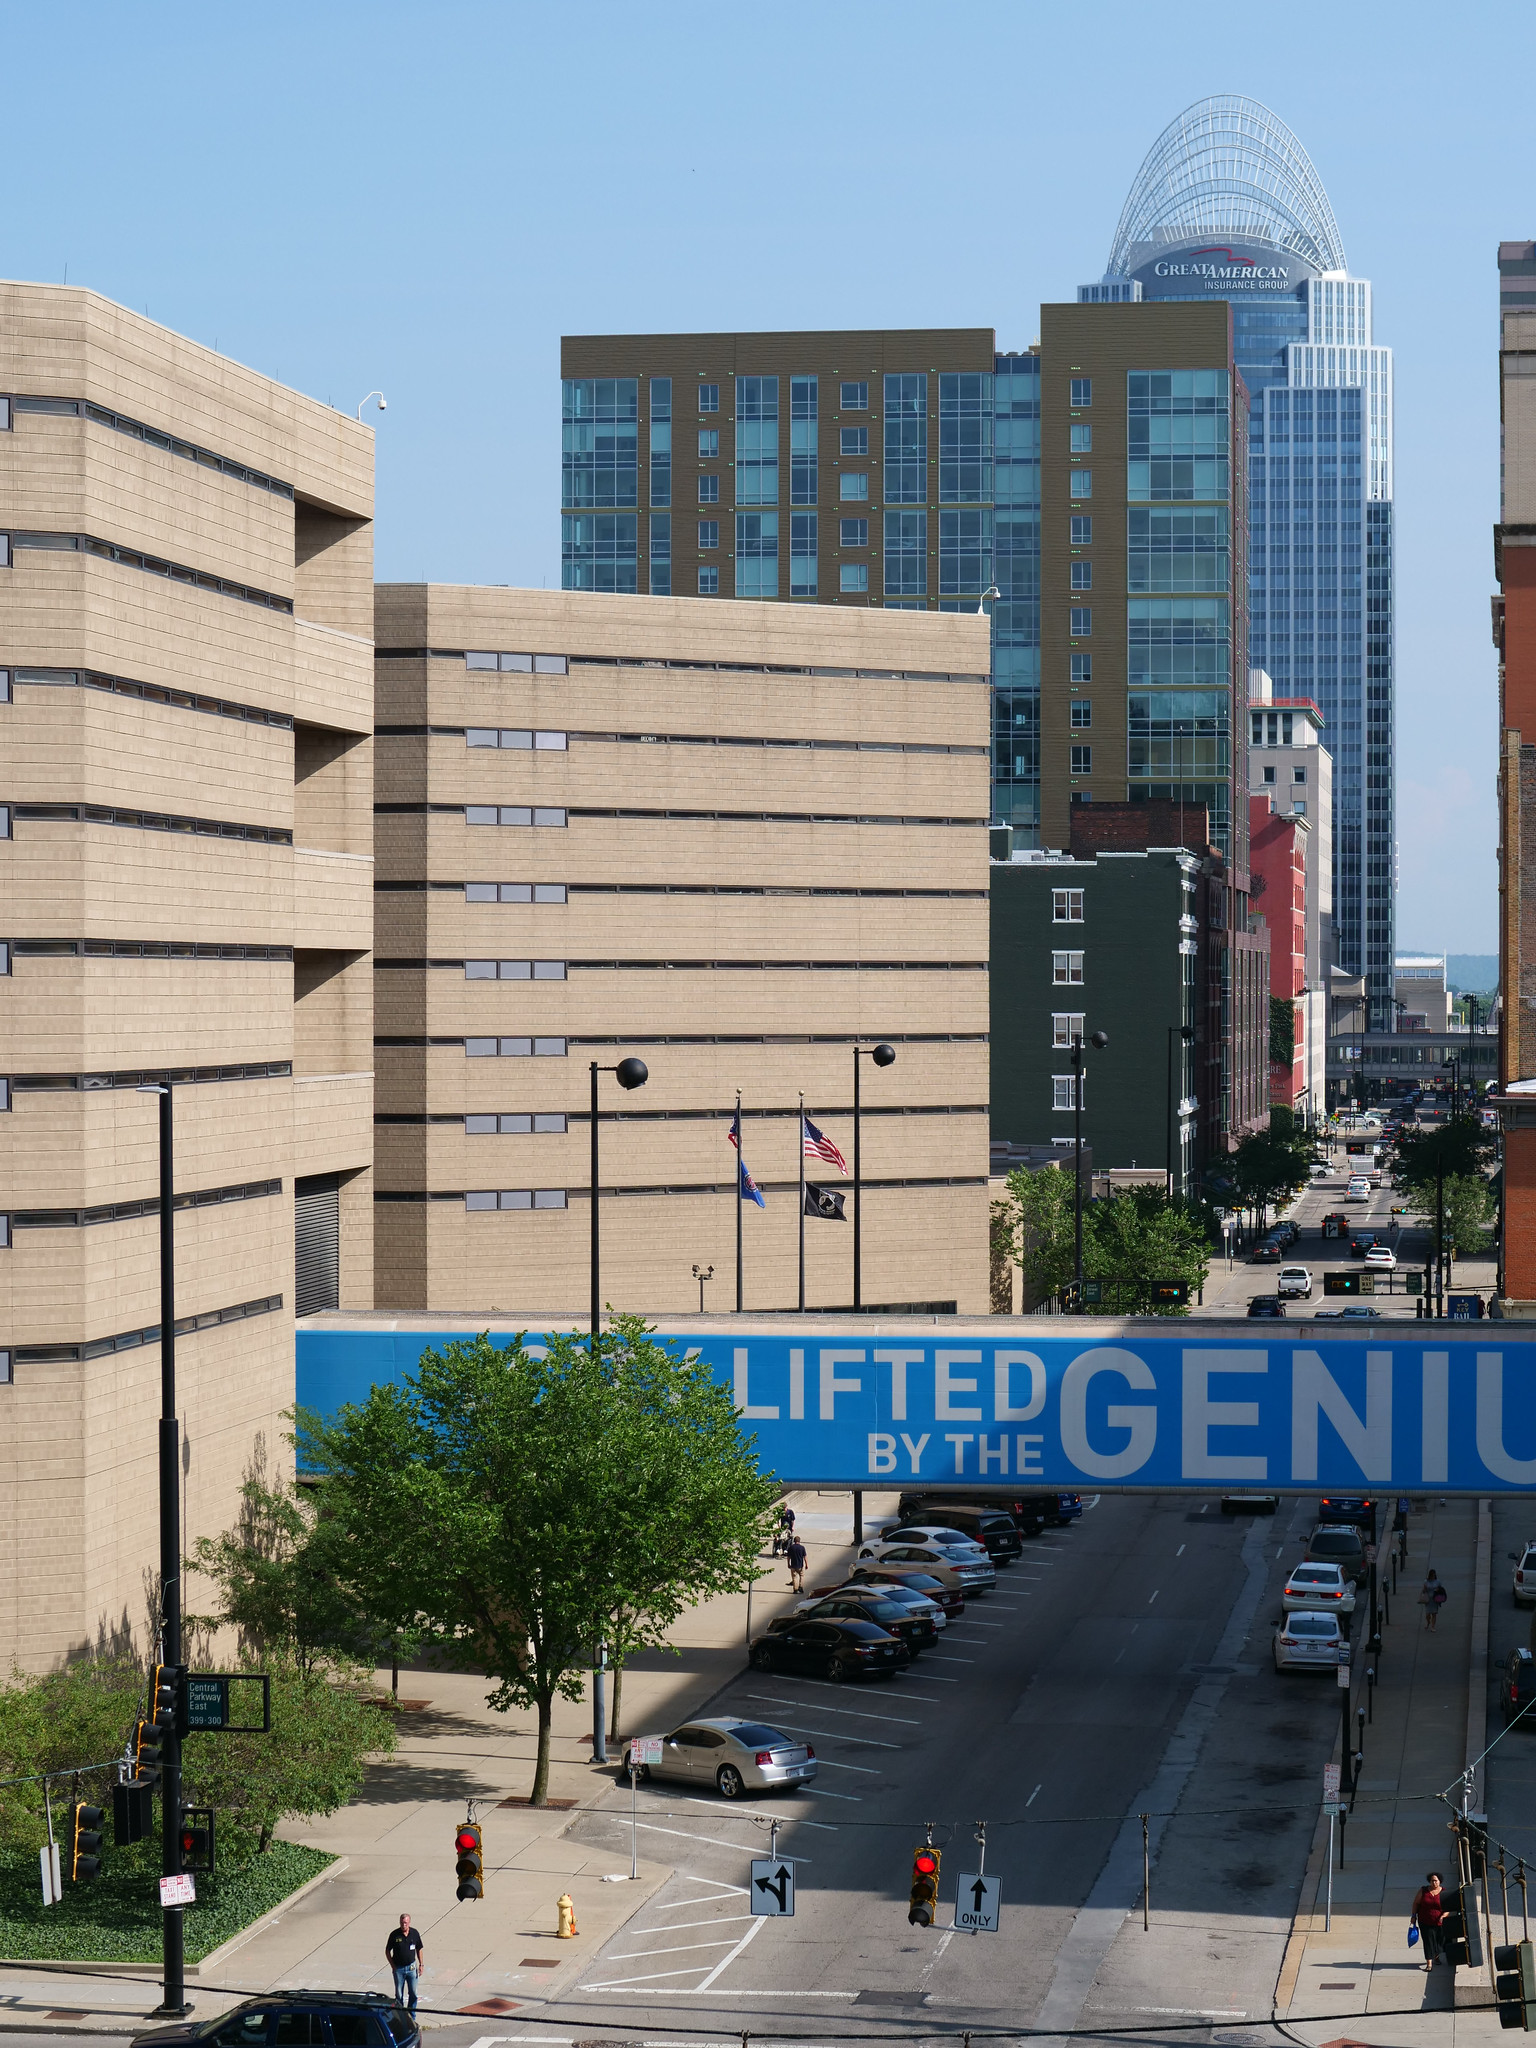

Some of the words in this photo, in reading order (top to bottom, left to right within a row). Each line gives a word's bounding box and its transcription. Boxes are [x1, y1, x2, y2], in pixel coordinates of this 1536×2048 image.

[1204, 281, 1256, 290] INSURANCE
[1258, 280, 1290, 290] GROUP
[733, 1347, 1047, 1422] LIFTED
[867, 1432, 931, 1474] BY
[944, 1433, 1044, 1475] THE
[189, 1682, 218, 1692] Central
[189, 1692, 222, 1703] Parkway
[189, 1700, 207, 1711] East
[961, 1913, 992, 1927] ONLY
